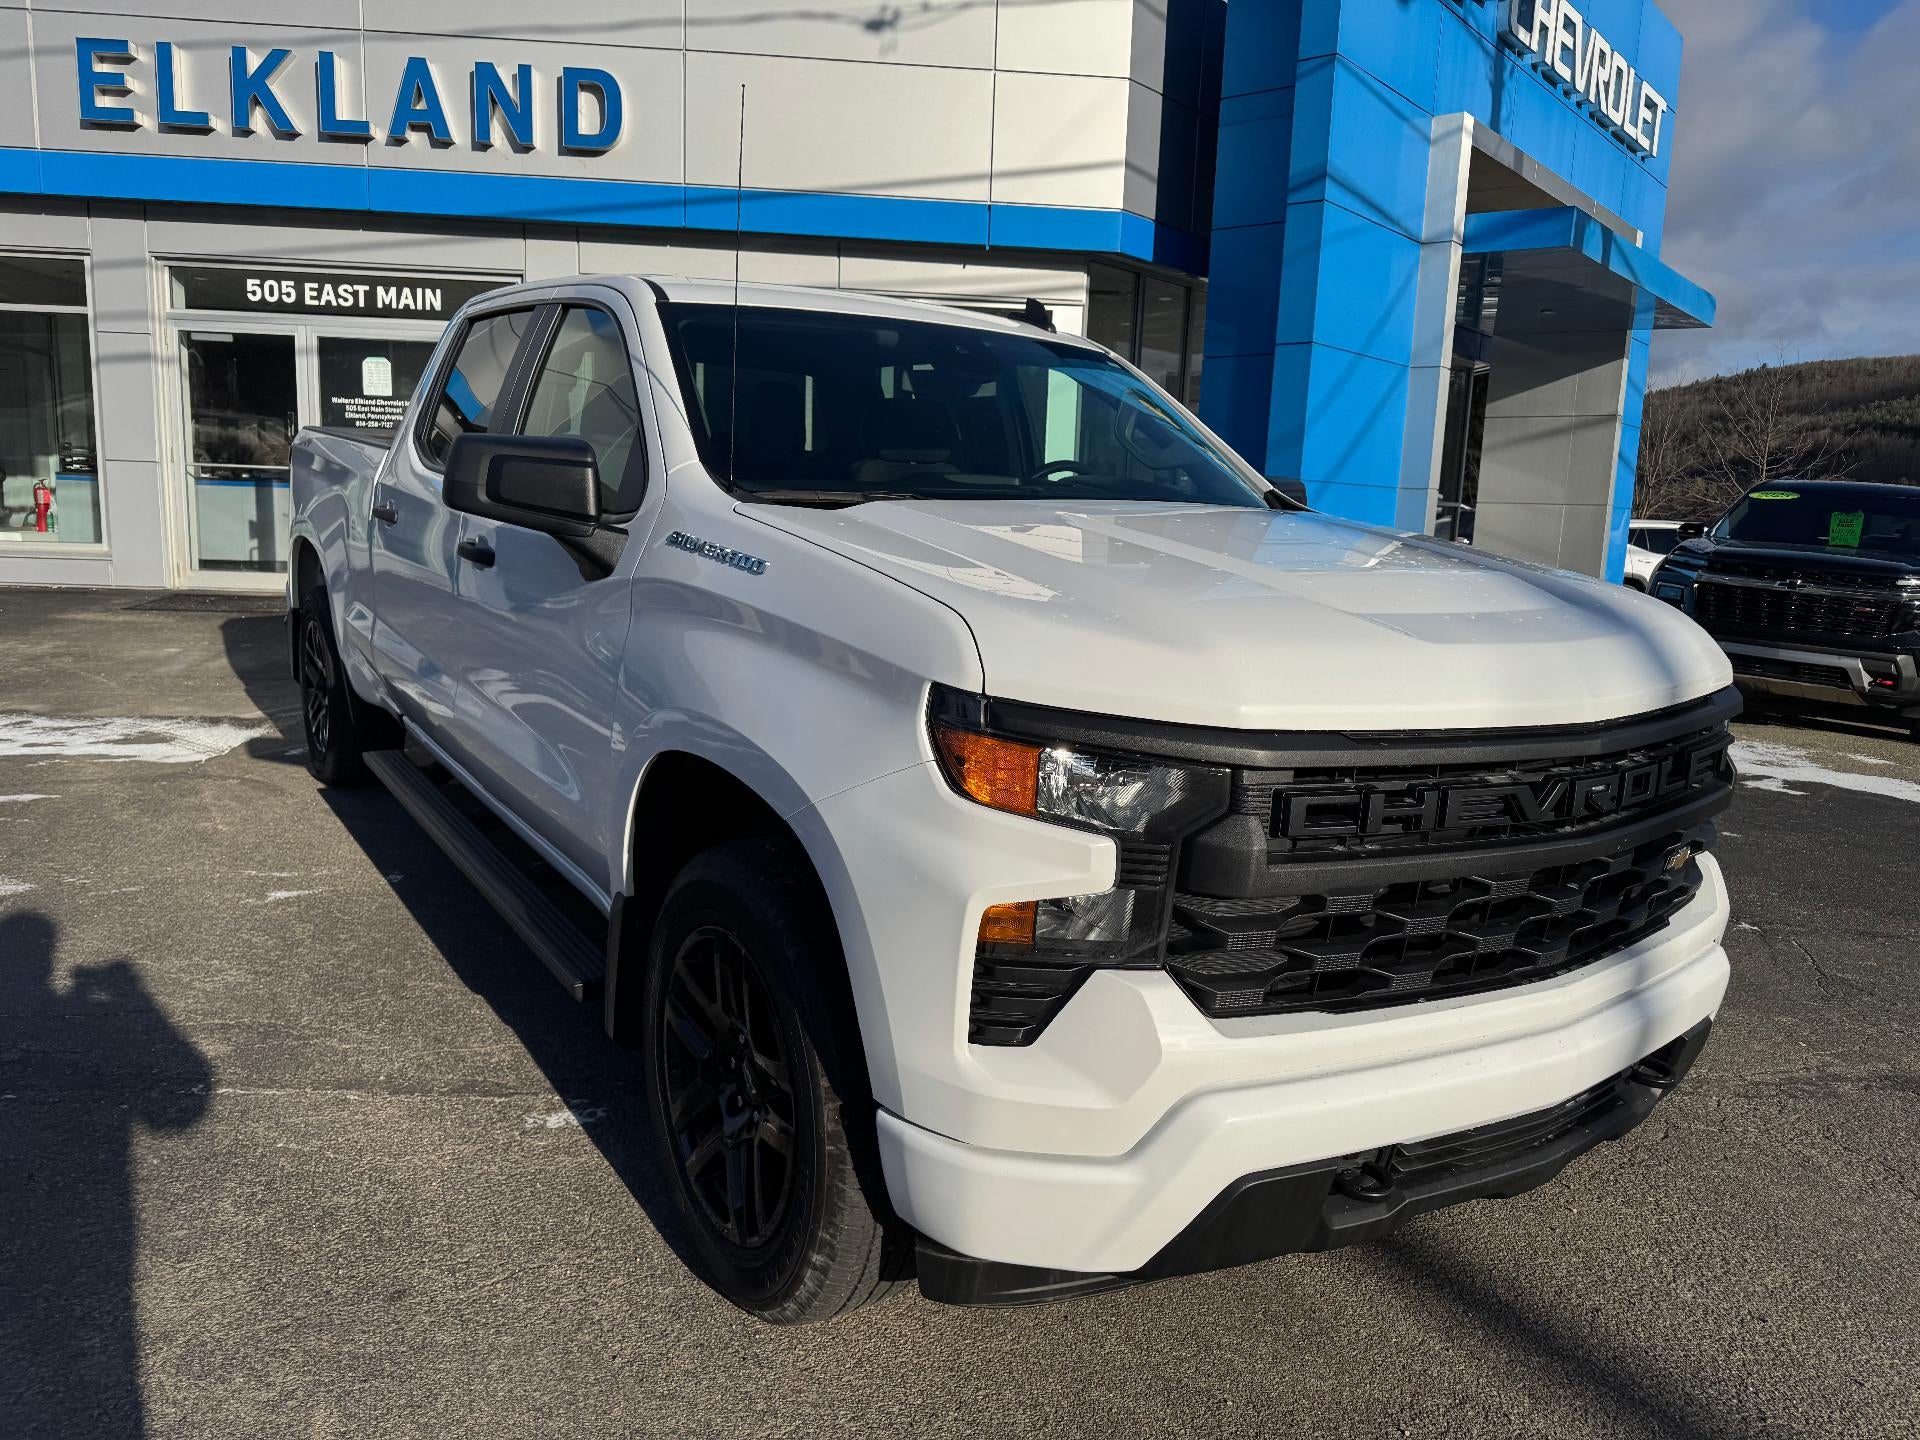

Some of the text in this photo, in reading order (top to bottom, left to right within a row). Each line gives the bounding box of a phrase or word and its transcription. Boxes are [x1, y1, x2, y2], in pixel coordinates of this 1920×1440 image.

[75, 36, 625, 151] ELKLAND
[246, 278, 442, 311] 505 EAST MAIN
[331, 396, 355, 405] Walters
[355, 397, 376, 406] Elkland
[377, 398, 404, 407] Chevrolet
[385, 406, 403, 414] Street
[345, 412, 404, 421] Elkland, Pennsylvania
